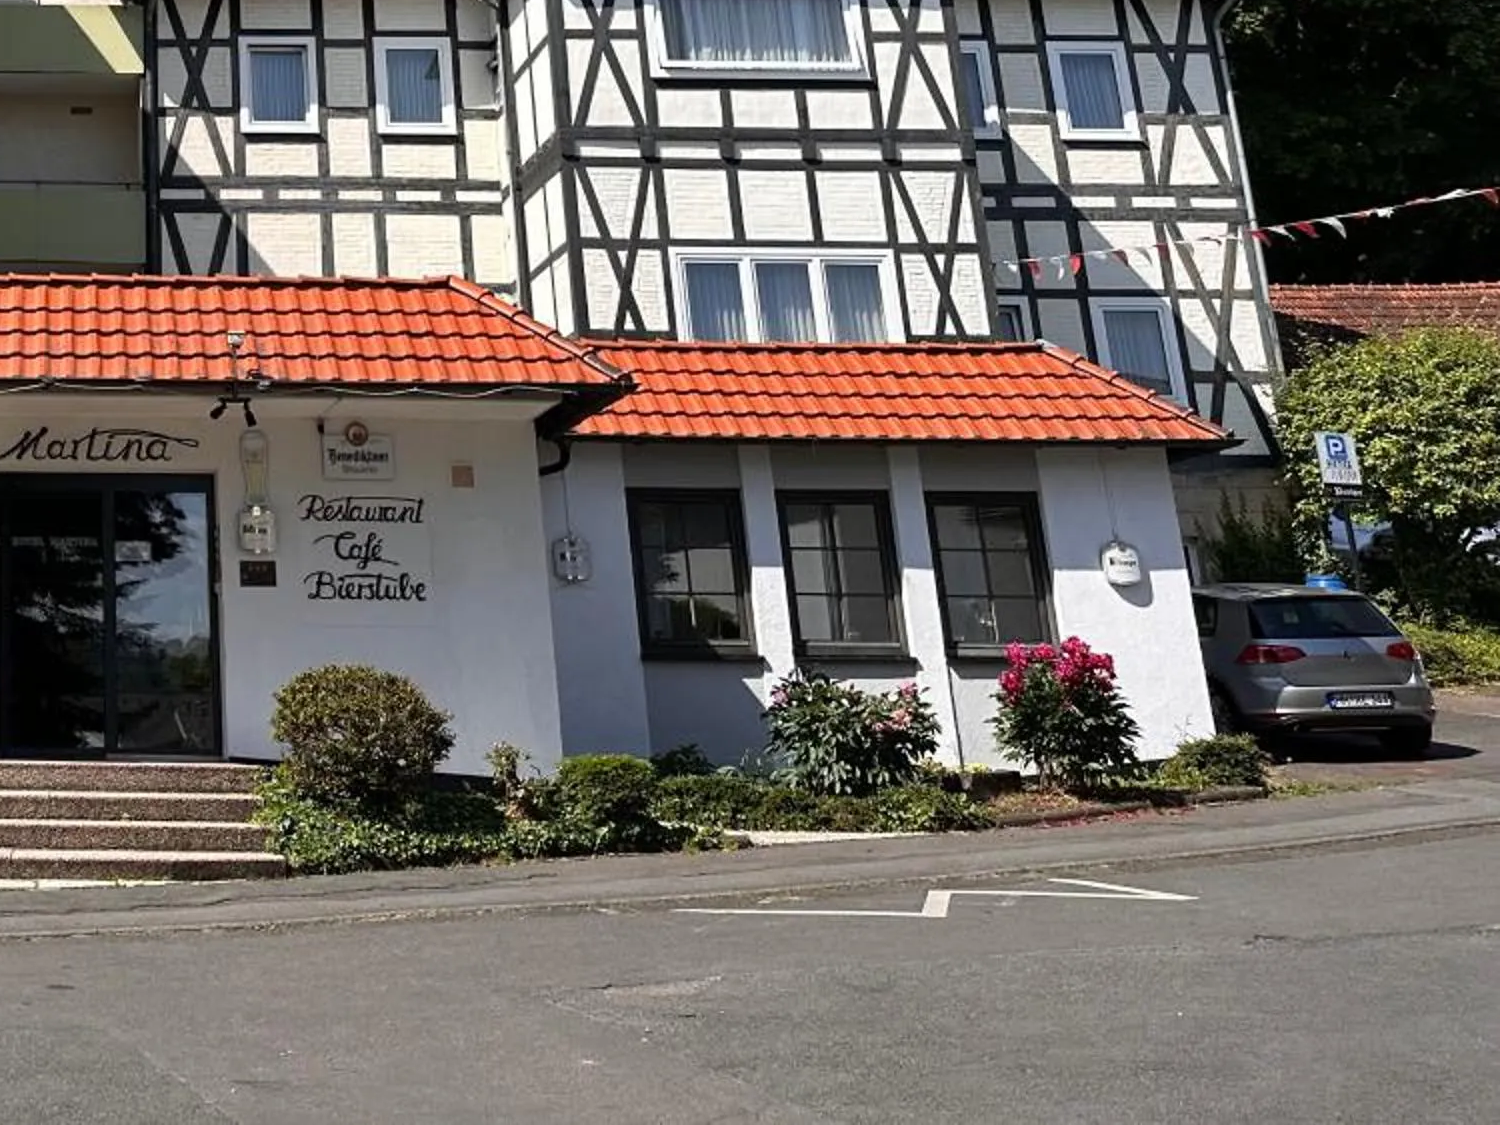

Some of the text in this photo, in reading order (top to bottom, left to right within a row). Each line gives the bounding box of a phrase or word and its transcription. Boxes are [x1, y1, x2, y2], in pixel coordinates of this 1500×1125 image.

[298, 494, 424, 523] Restaurant
[313, 531, 399, 569] Café
[304, 571, 427, 601] Bierstube
